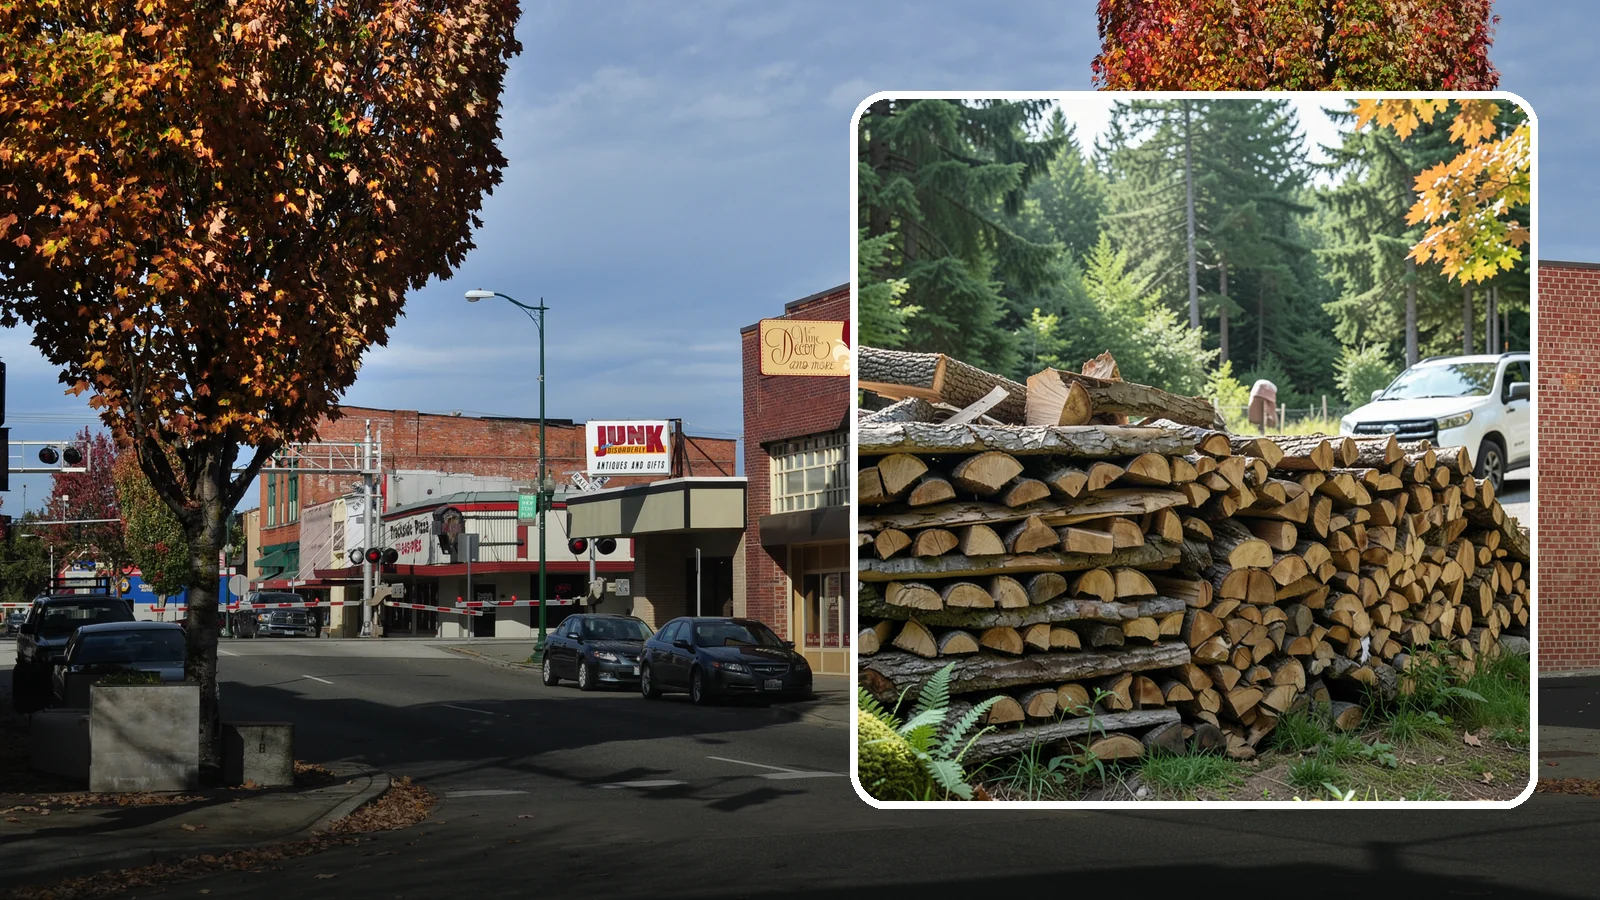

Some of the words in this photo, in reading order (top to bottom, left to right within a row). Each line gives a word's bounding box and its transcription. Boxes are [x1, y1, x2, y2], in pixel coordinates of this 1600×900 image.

[595, 425, 665, 457] JUNK
[597, 461, 628, 470] ANTIQUES
[631, 461, 643, 470] AND
[647, 460, 665, 470] GIFTS
[414, 519, 429, 534] Pizza
